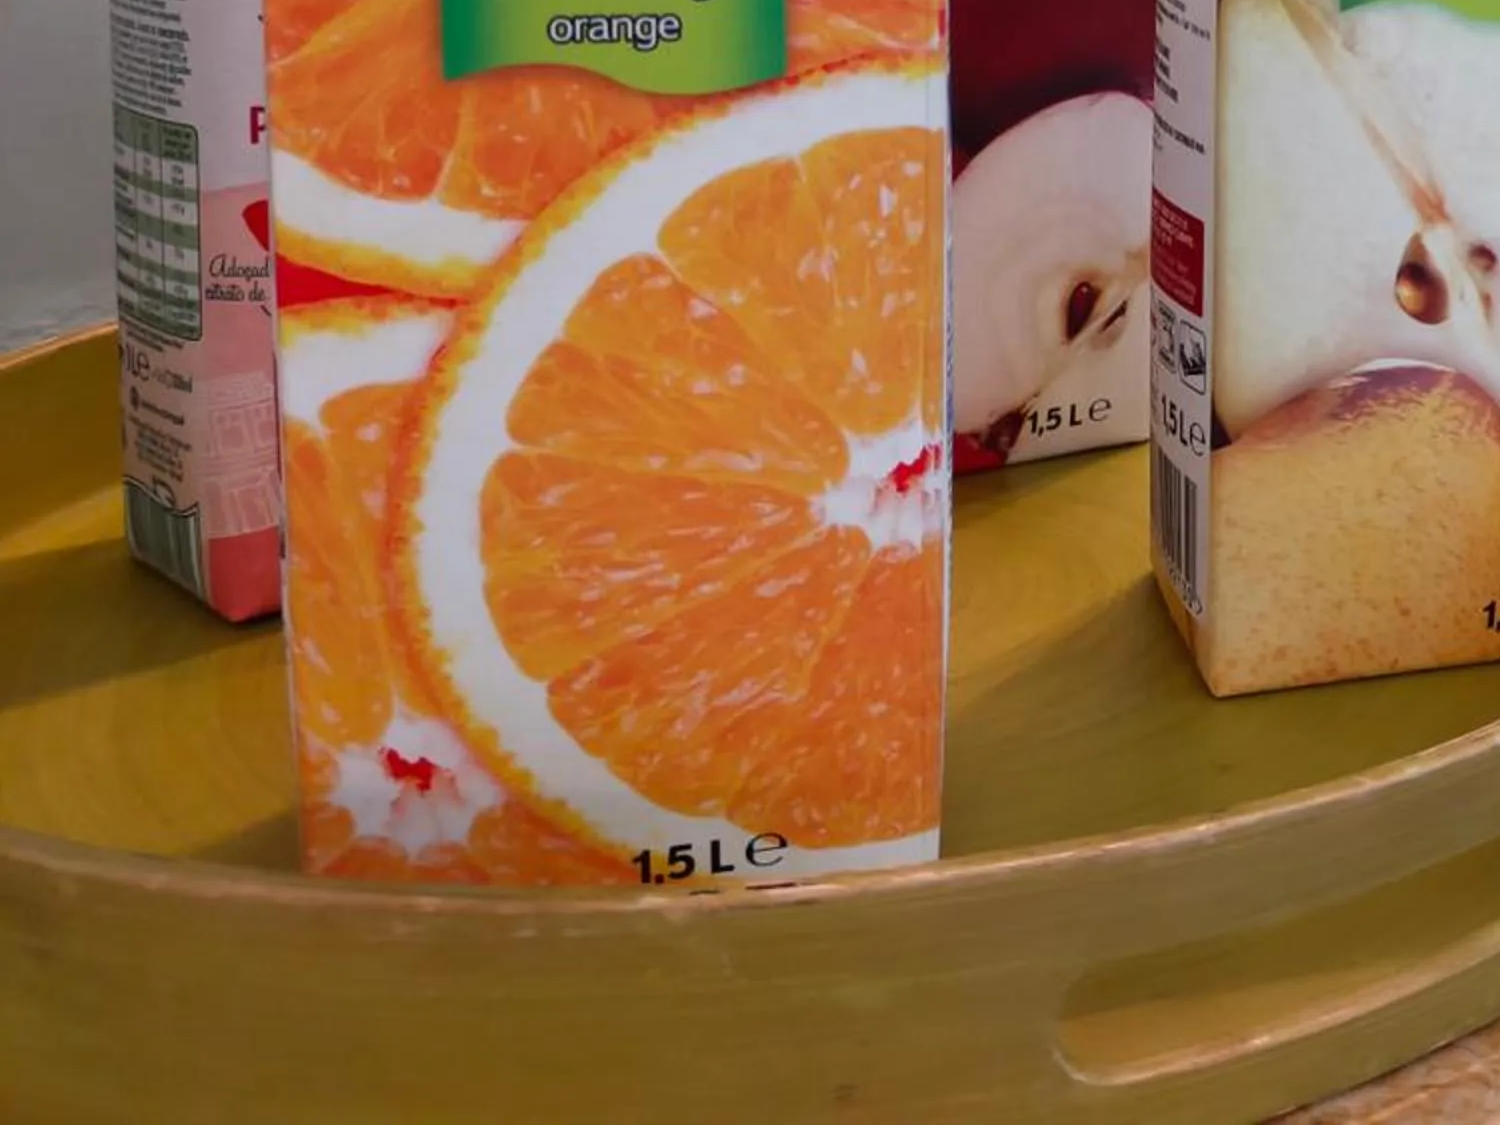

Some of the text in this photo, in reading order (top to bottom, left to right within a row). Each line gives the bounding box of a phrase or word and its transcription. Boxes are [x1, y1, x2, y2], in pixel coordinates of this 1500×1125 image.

[548, 13, 682, 52] orange
[209, 253, 270, 281] Adoçad
[1027, 407, 1062, 437] 1,5
